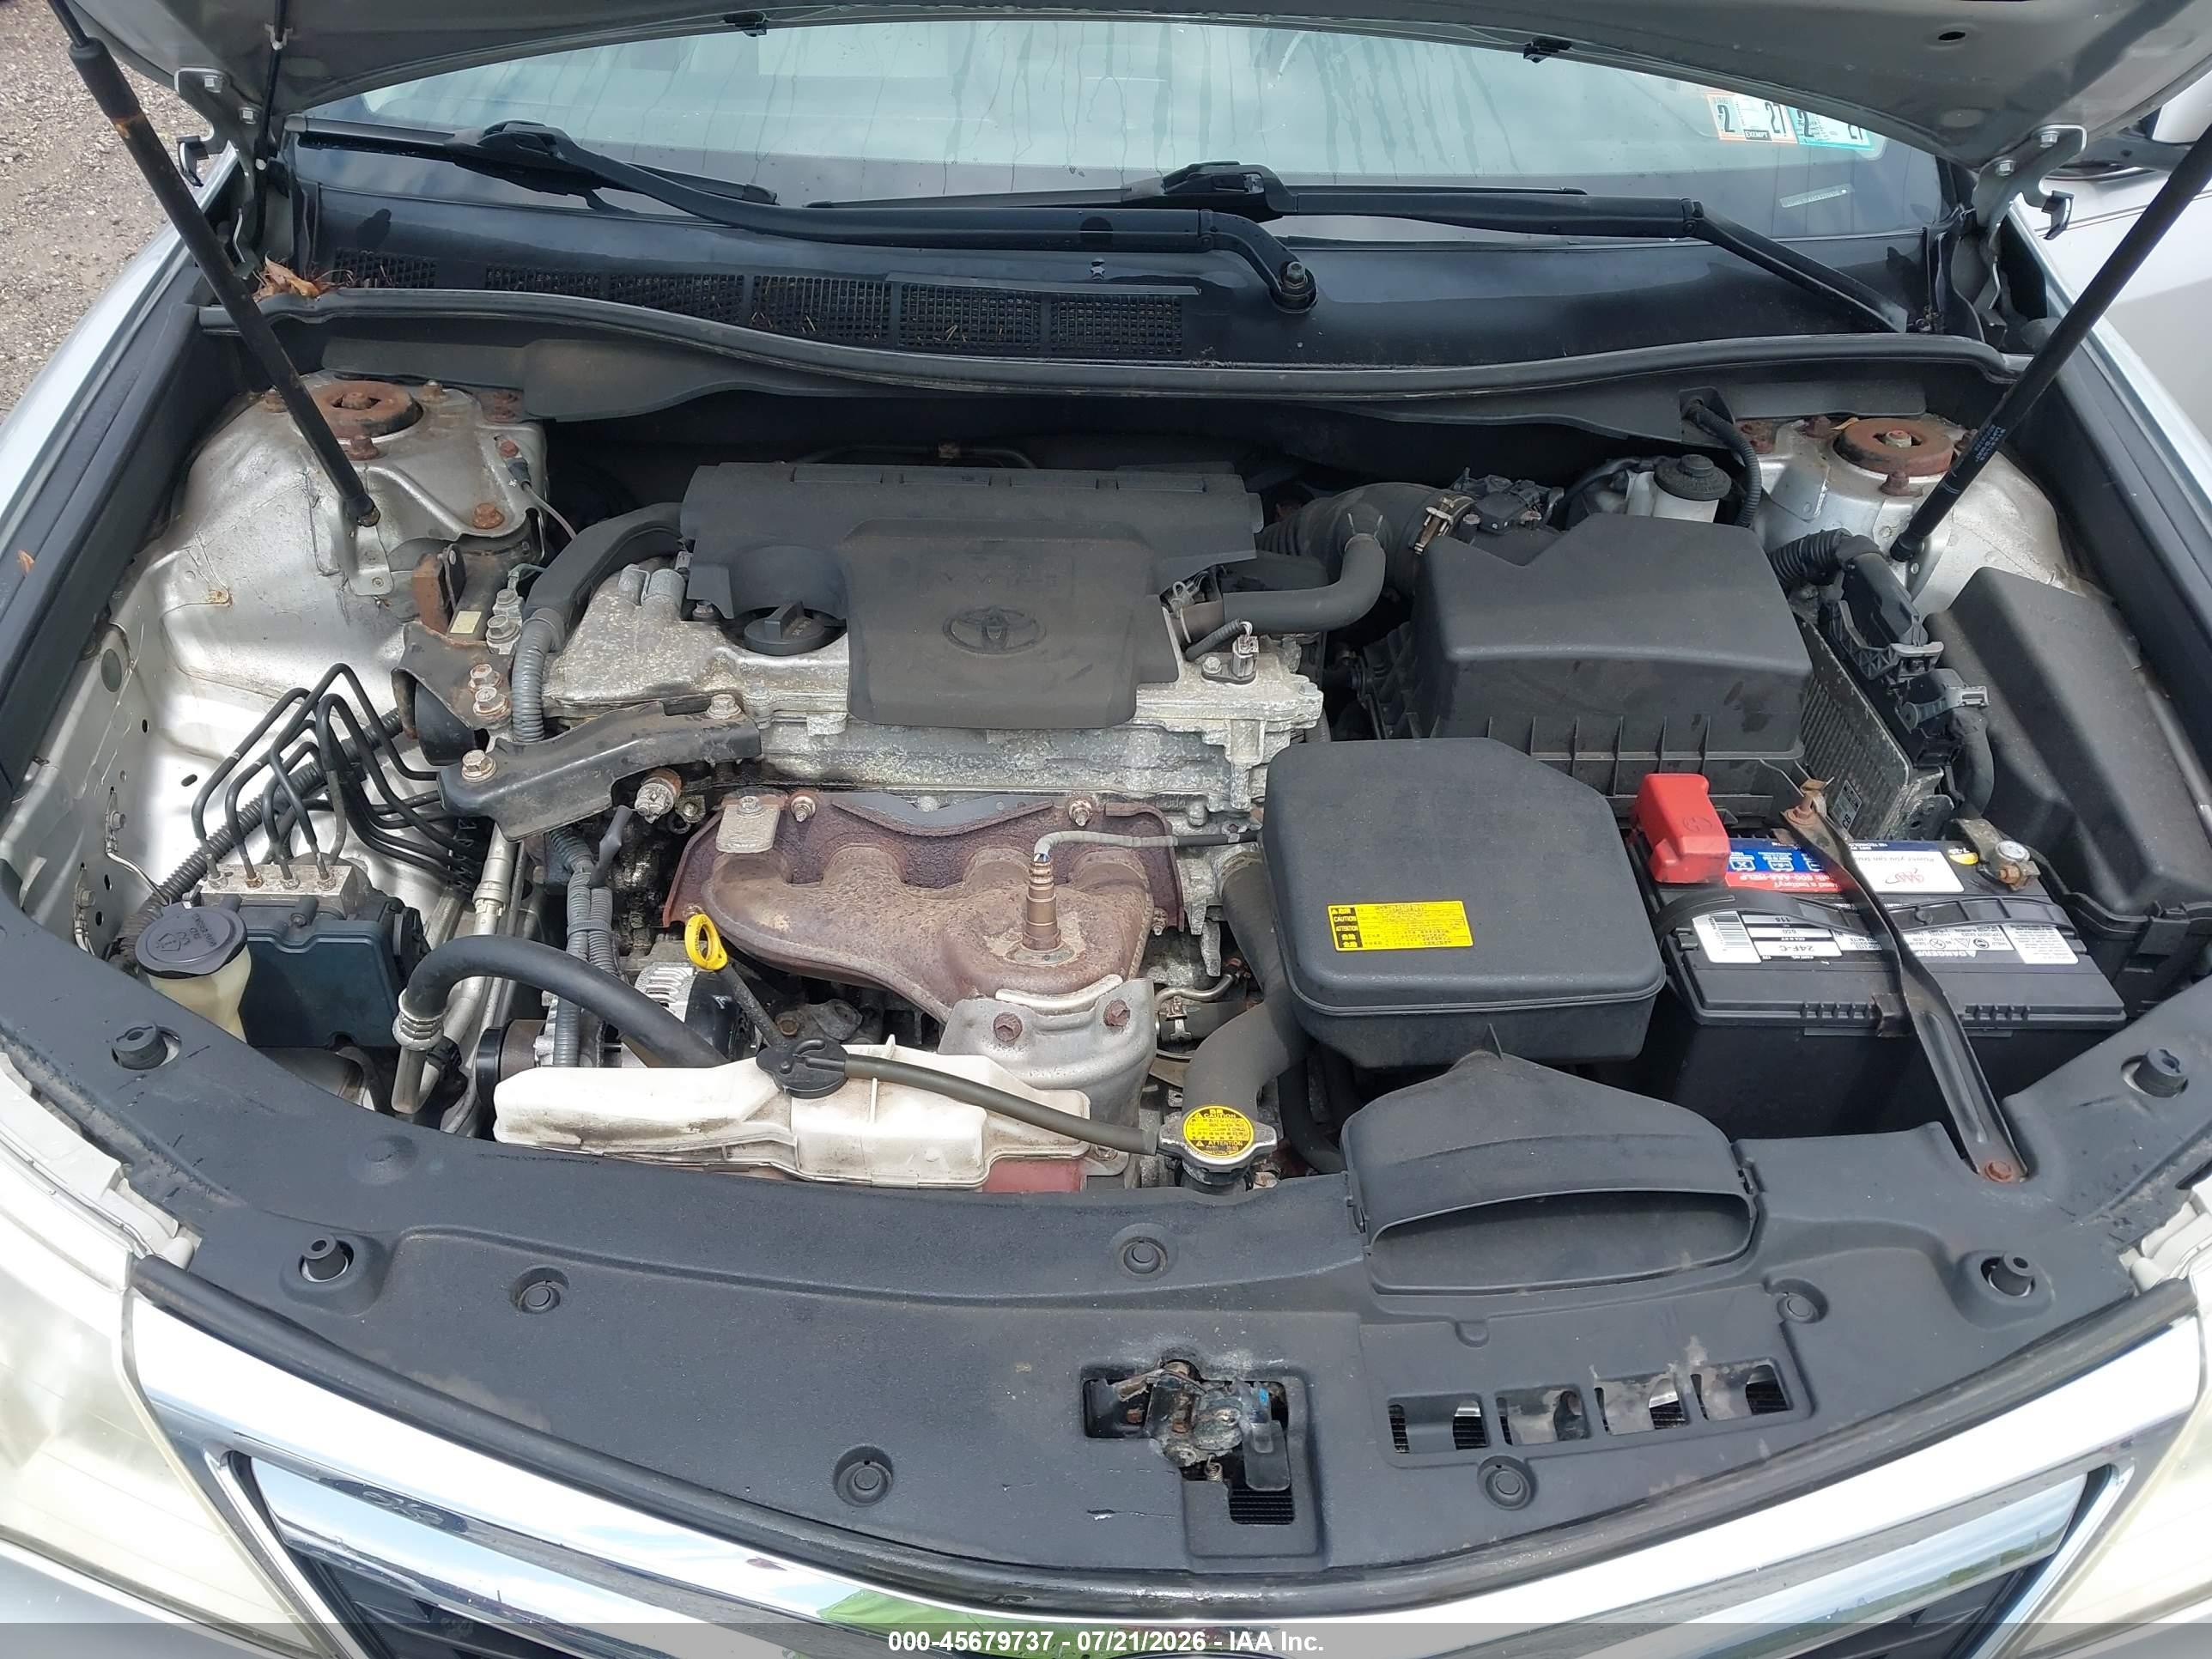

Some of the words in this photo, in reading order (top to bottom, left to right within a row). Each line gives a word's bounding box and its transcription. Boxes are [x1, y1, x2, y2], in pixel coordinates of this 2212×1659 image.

[1717, 104, 1735, 133] 2
[1765, 101, 1786, 134] 27
[1744, 130, 1770, 139] EXEMPT
[1739, 873, 1814, 882] 800-AAA-HELP
